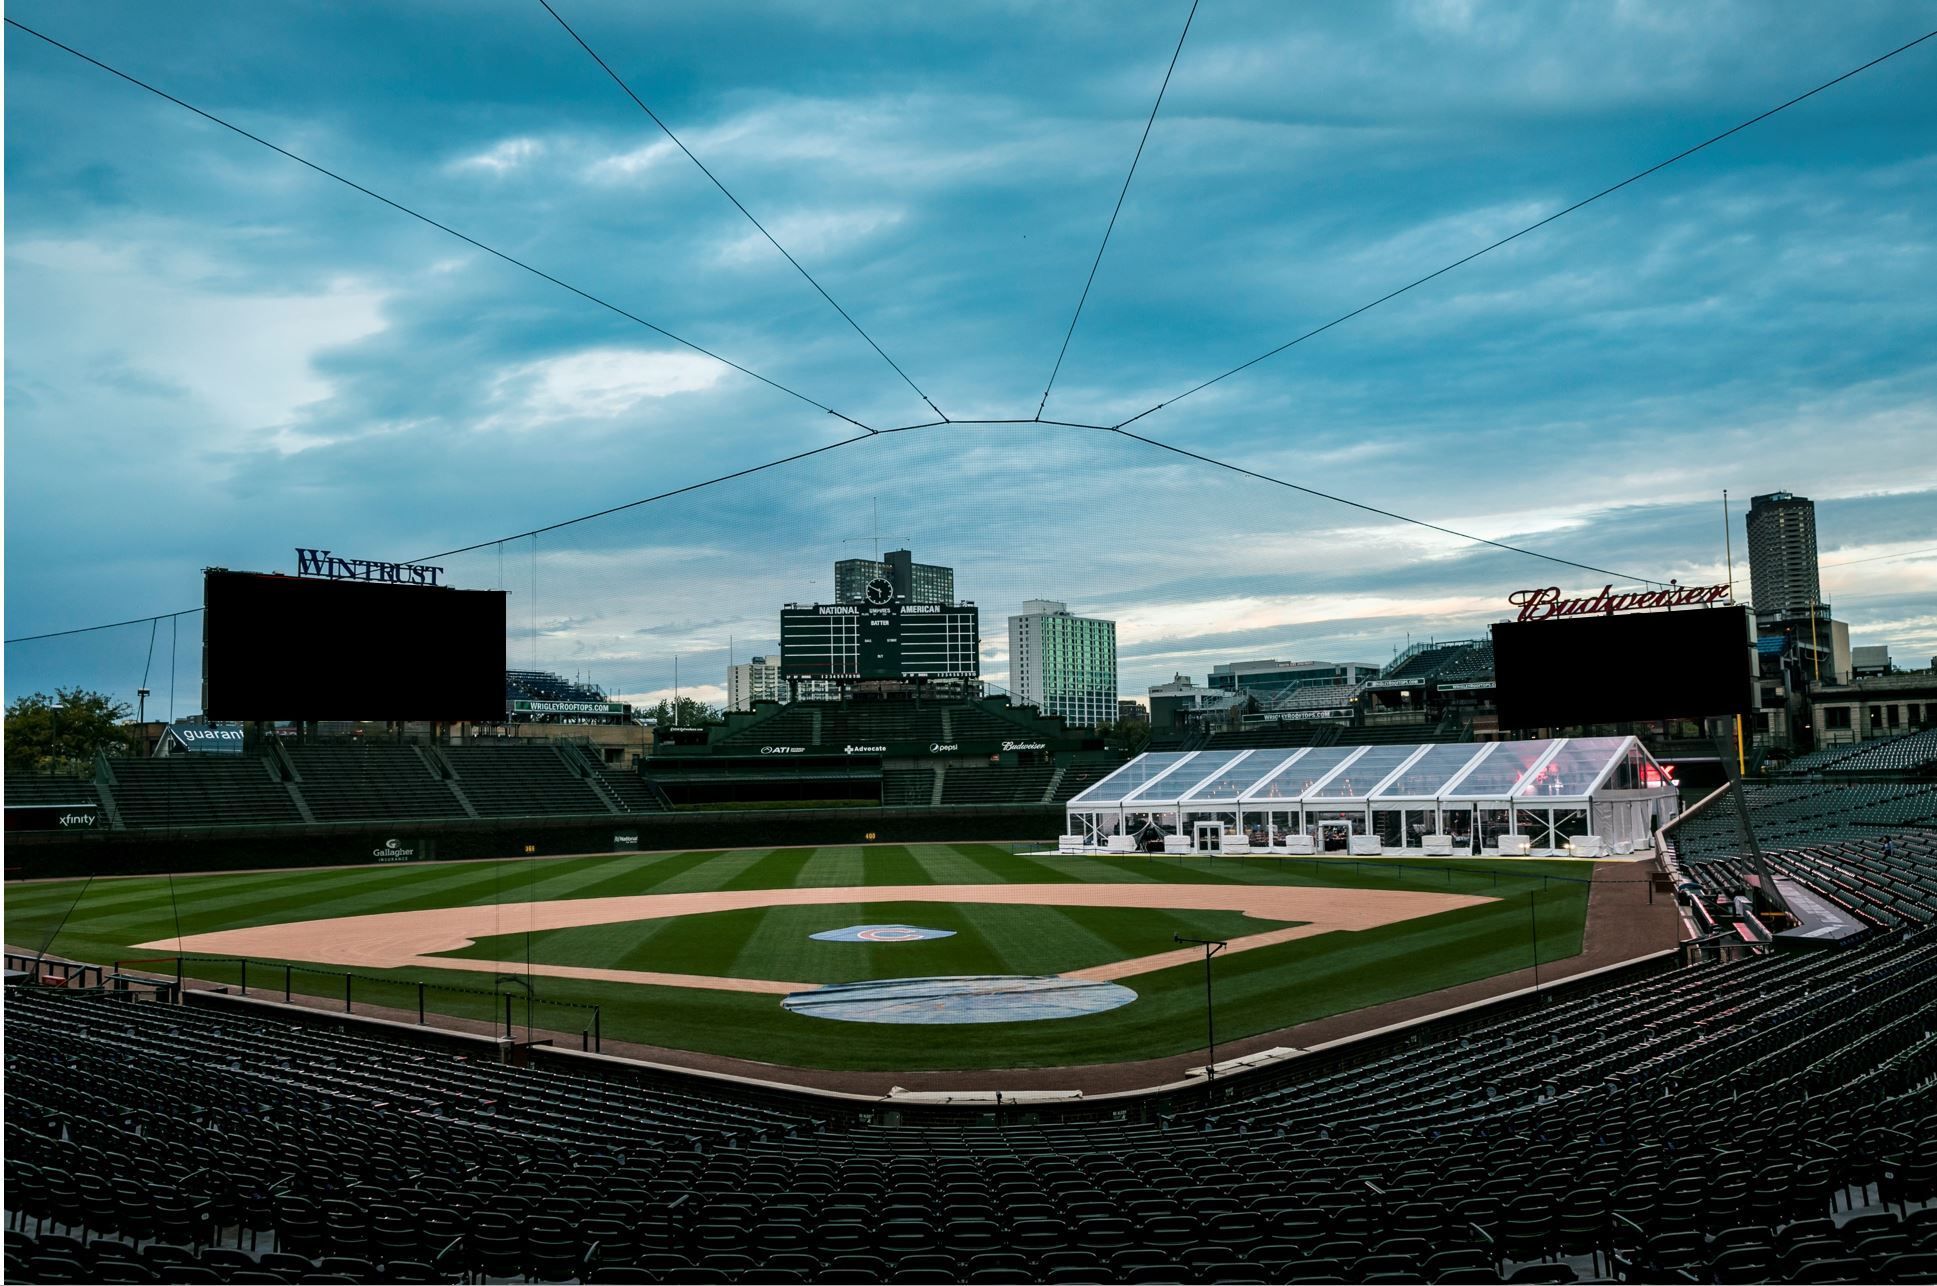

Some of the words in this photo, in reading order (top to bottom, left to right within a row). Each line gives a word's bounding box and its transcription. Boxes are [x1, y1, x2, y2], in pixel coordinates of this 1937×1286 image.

[295, 548, 444, 586] WINTRUST
[1508, 584, 1731, 622] Budweiser
[819, 606, 860, 615] NATIONAL
[900, 605, 940, 613] AMERICAN
[530, 702, 609, 712] WRIGLEYROOFTOPS.COM
[939, 744, 958, 752] pepsi
[1001, 741, 1046, 751] Budweiser
[59, 813, 96, 826] xfinity
[373, 848, 414, 857] Gallagher
